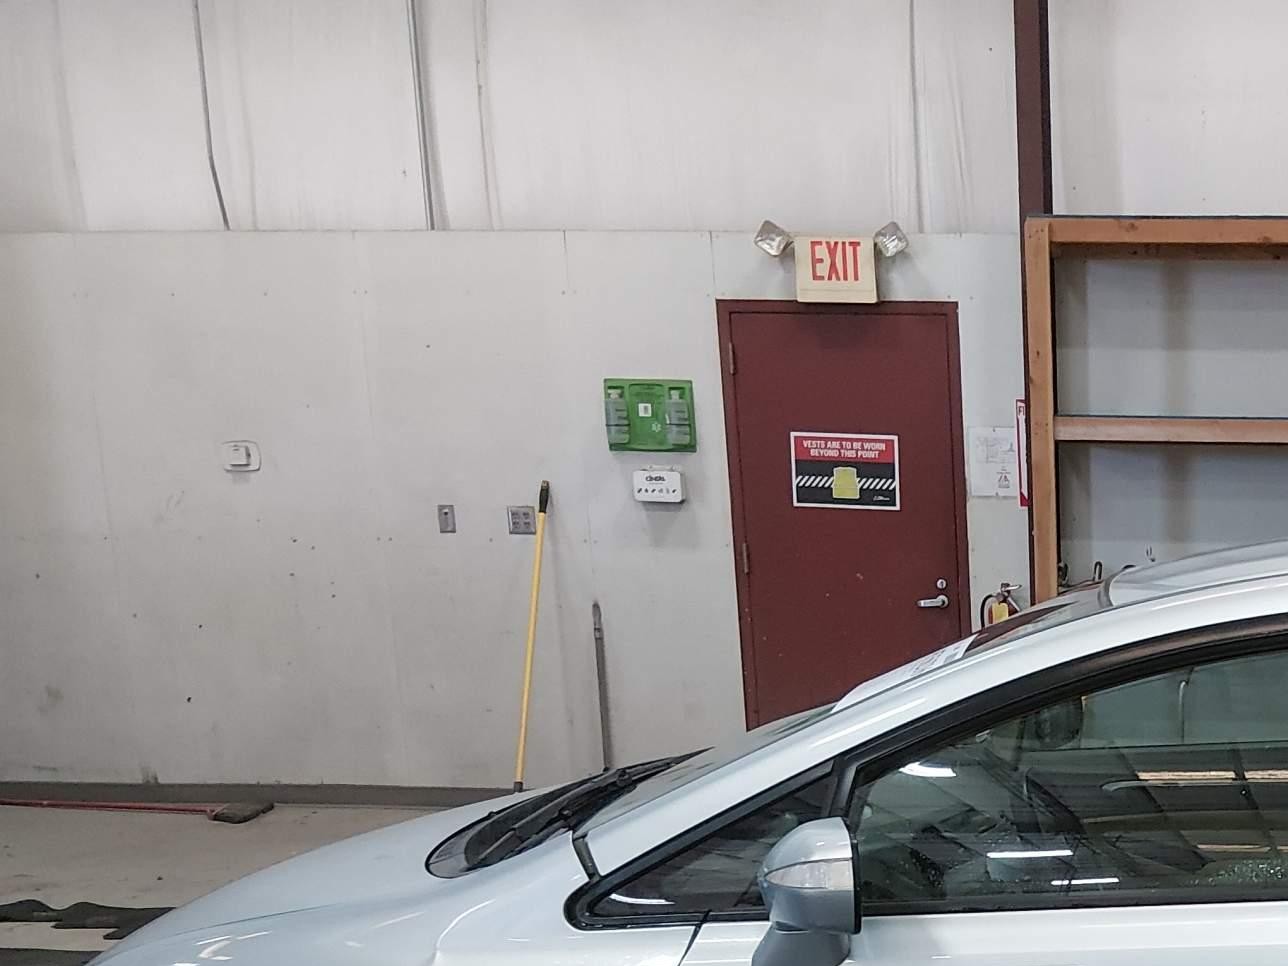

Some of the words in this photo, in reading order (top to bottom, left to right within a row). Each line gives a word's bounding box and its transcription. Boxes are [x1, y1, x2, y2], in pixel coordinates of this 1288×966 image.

[810, 240, 861, 282] EXIT
[803, 440, 825, 448] VESTS
[826, 441, 841, 449] ARE
[842, 441, 851, 449] TO
[853, 442, 862, 450] BE
[863, 442, 886, 451] WORN
[810, 449, 839, 457] BEYOND
[841, 449, 856, 458] THIS
[858, 450, 879, 458] POINT
